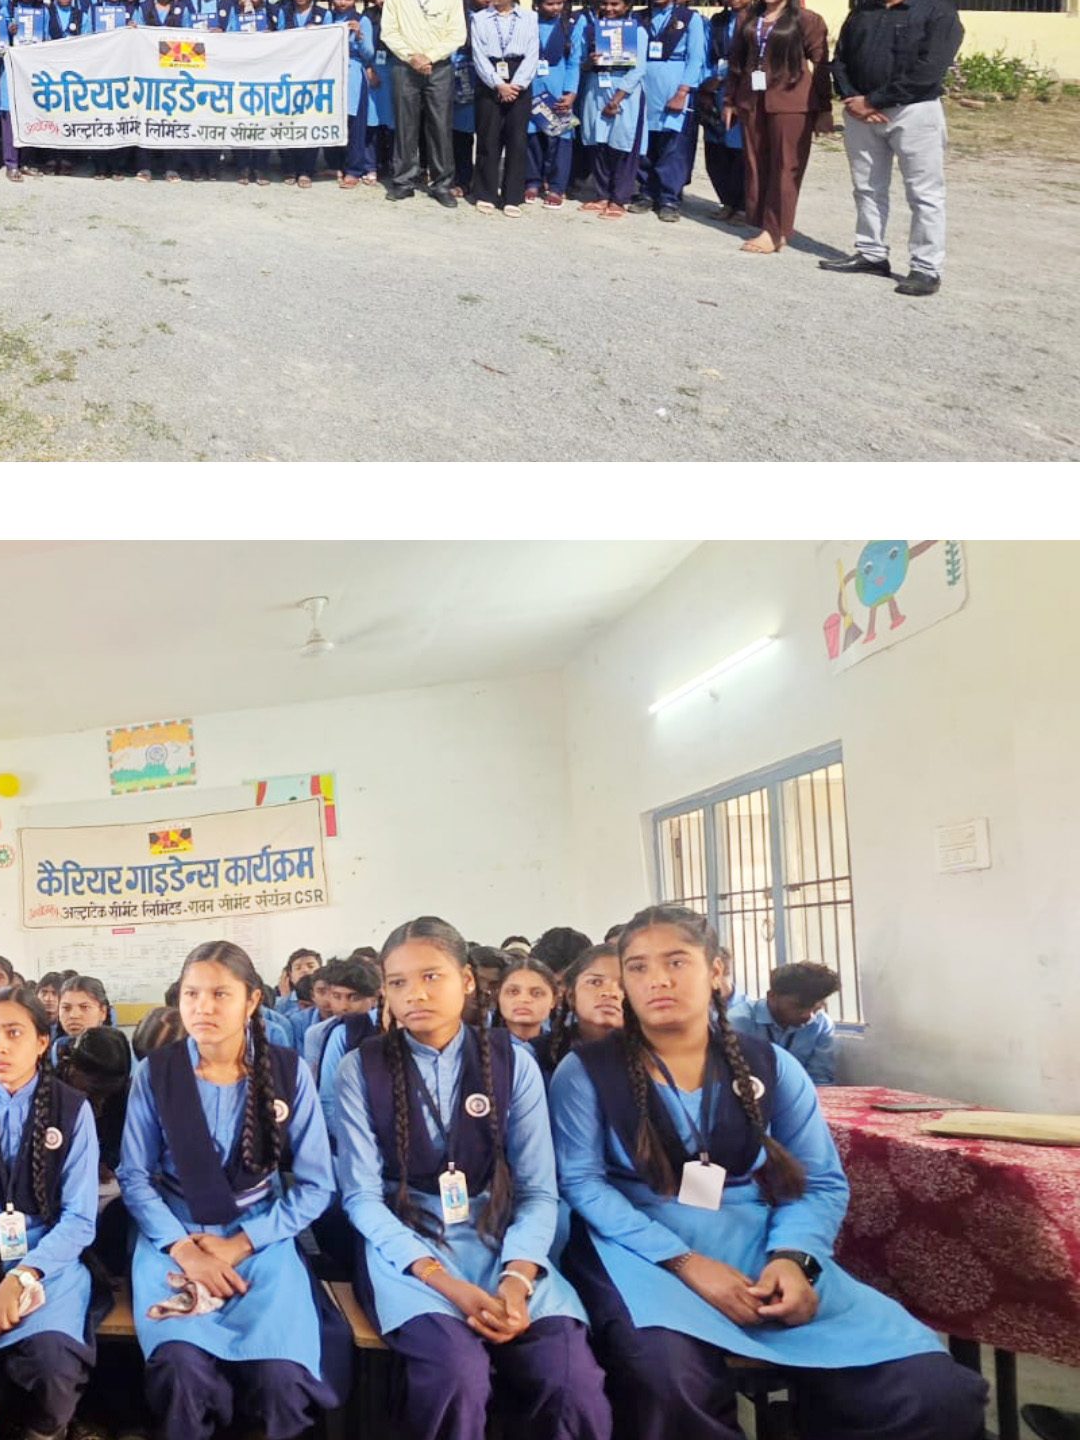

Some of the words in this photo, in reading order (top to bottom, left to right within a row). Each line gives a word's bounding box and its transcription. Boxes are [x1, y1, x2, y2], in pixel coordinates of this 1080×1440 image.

[31, 70, 131, 112] कैरियर
[133, 70, 235, 116] गाइडेन्स
[238, 73, 336, 117] कार्यक्रम
[310, 124, 340, 141] CSR
[36, 859, 122, 897] कैरियर
[125, 855, 221, 897] गाइडेन्स
[224, 844, 316, 888] कार्यक्रम
[294, 888, 325, 904] CSR
